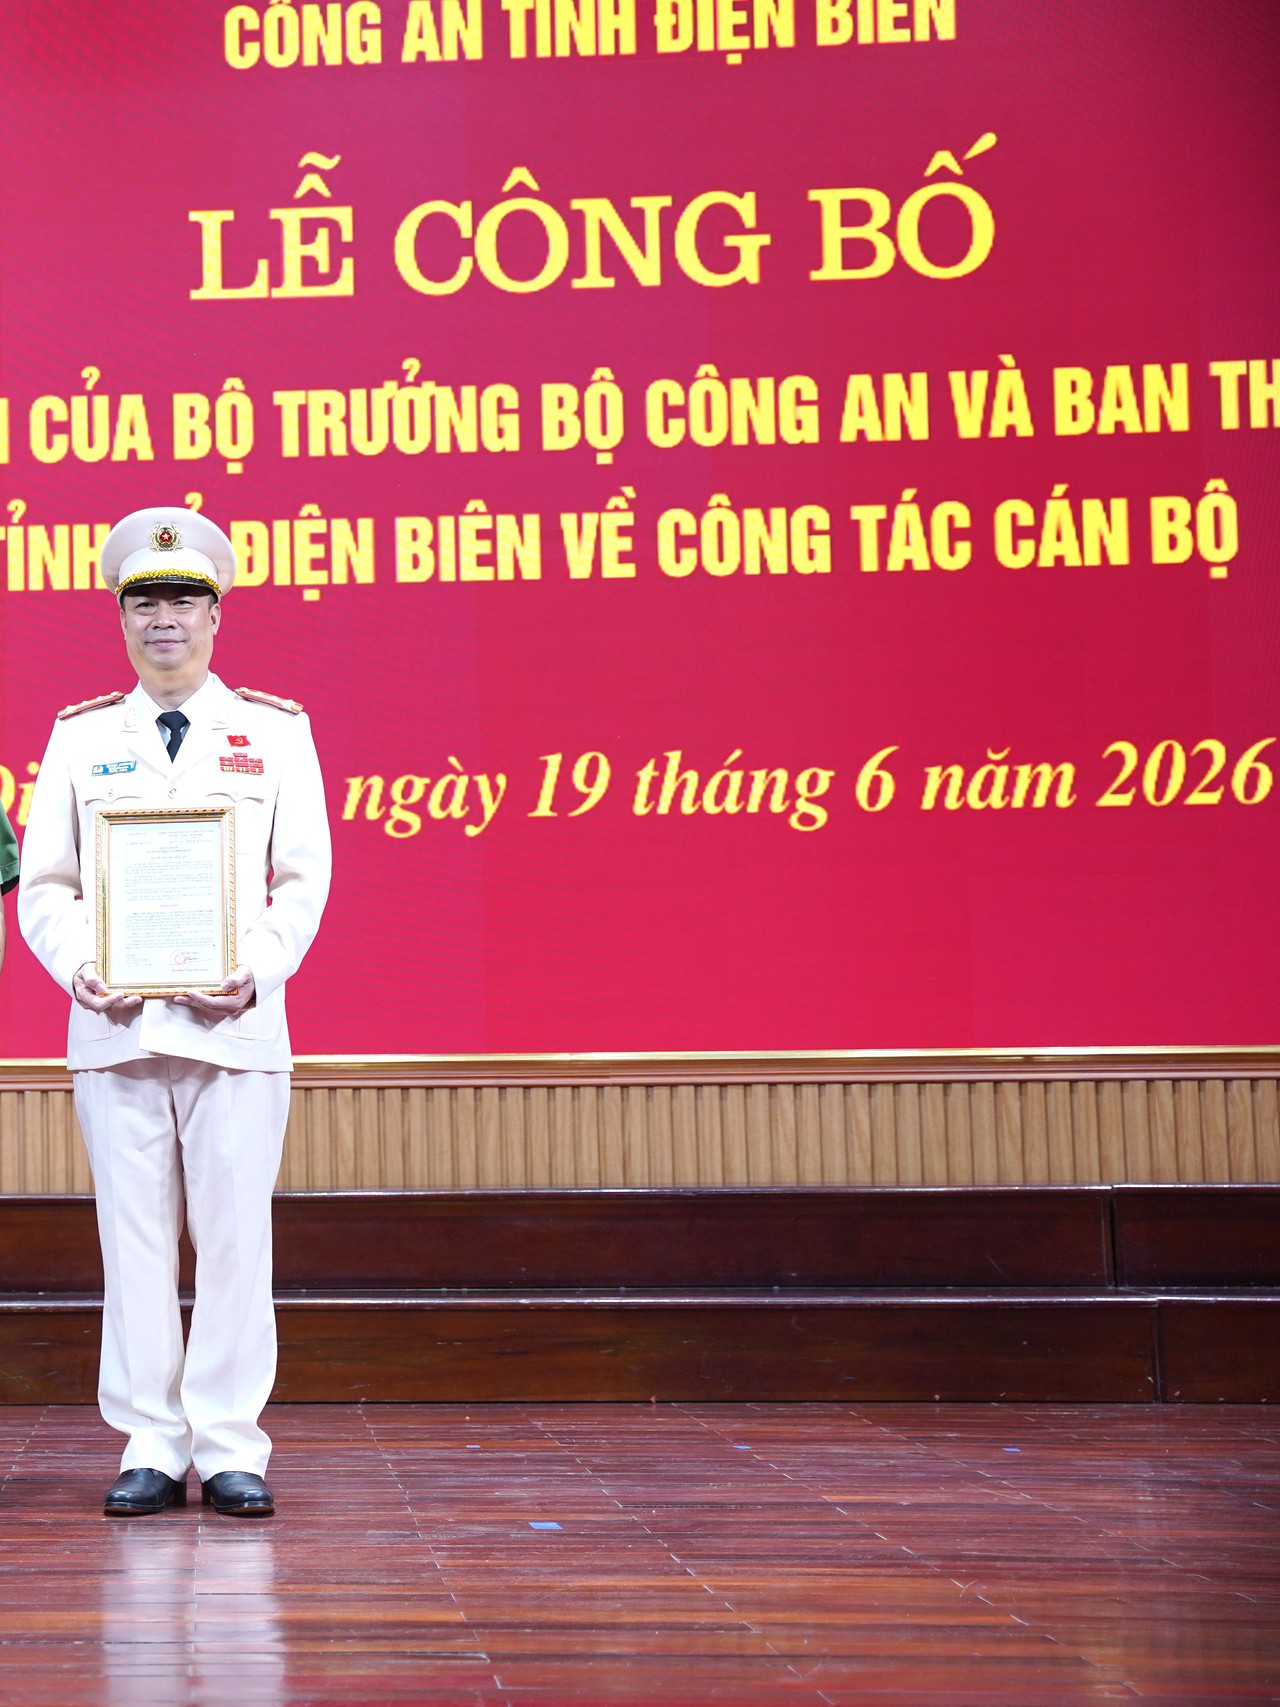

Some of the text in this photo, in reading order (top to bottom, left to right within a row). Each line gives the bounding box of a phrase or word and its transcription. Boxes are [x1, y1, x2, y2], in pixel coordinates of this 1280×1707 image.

[401, 0, 483, 63] AN
[189, 132, 997, 300] LỄ CÔNG BỐ
[29, 365, 155, 464] CỦA
[172, 377, 254, 474] BỘ
[273, 357, 520, 458] TRƯỞNG
[541, 367, 625, 465] BỘ
[645, 363, 820, 449] CÔNG
[840, 371, 930, 443] AN
[948, 353, 1034, 439] VÀ
[1053, 362, 1190, 436] BAN
[230, 503, 375, 601] ĐIỆN
[396, 499, 542, 583] BIÊN
[560, 486, 637, 579] VỀ
[657, 493, 832, 578] CÔNG
[850, 488, 972, 574] TÁC
[994, 483, 1130, 569] CÁN
[1150, 478, 1239, 579] BỘ
[342, 737, 1276, 838] ngày 19 tháng 6 năm 2026
